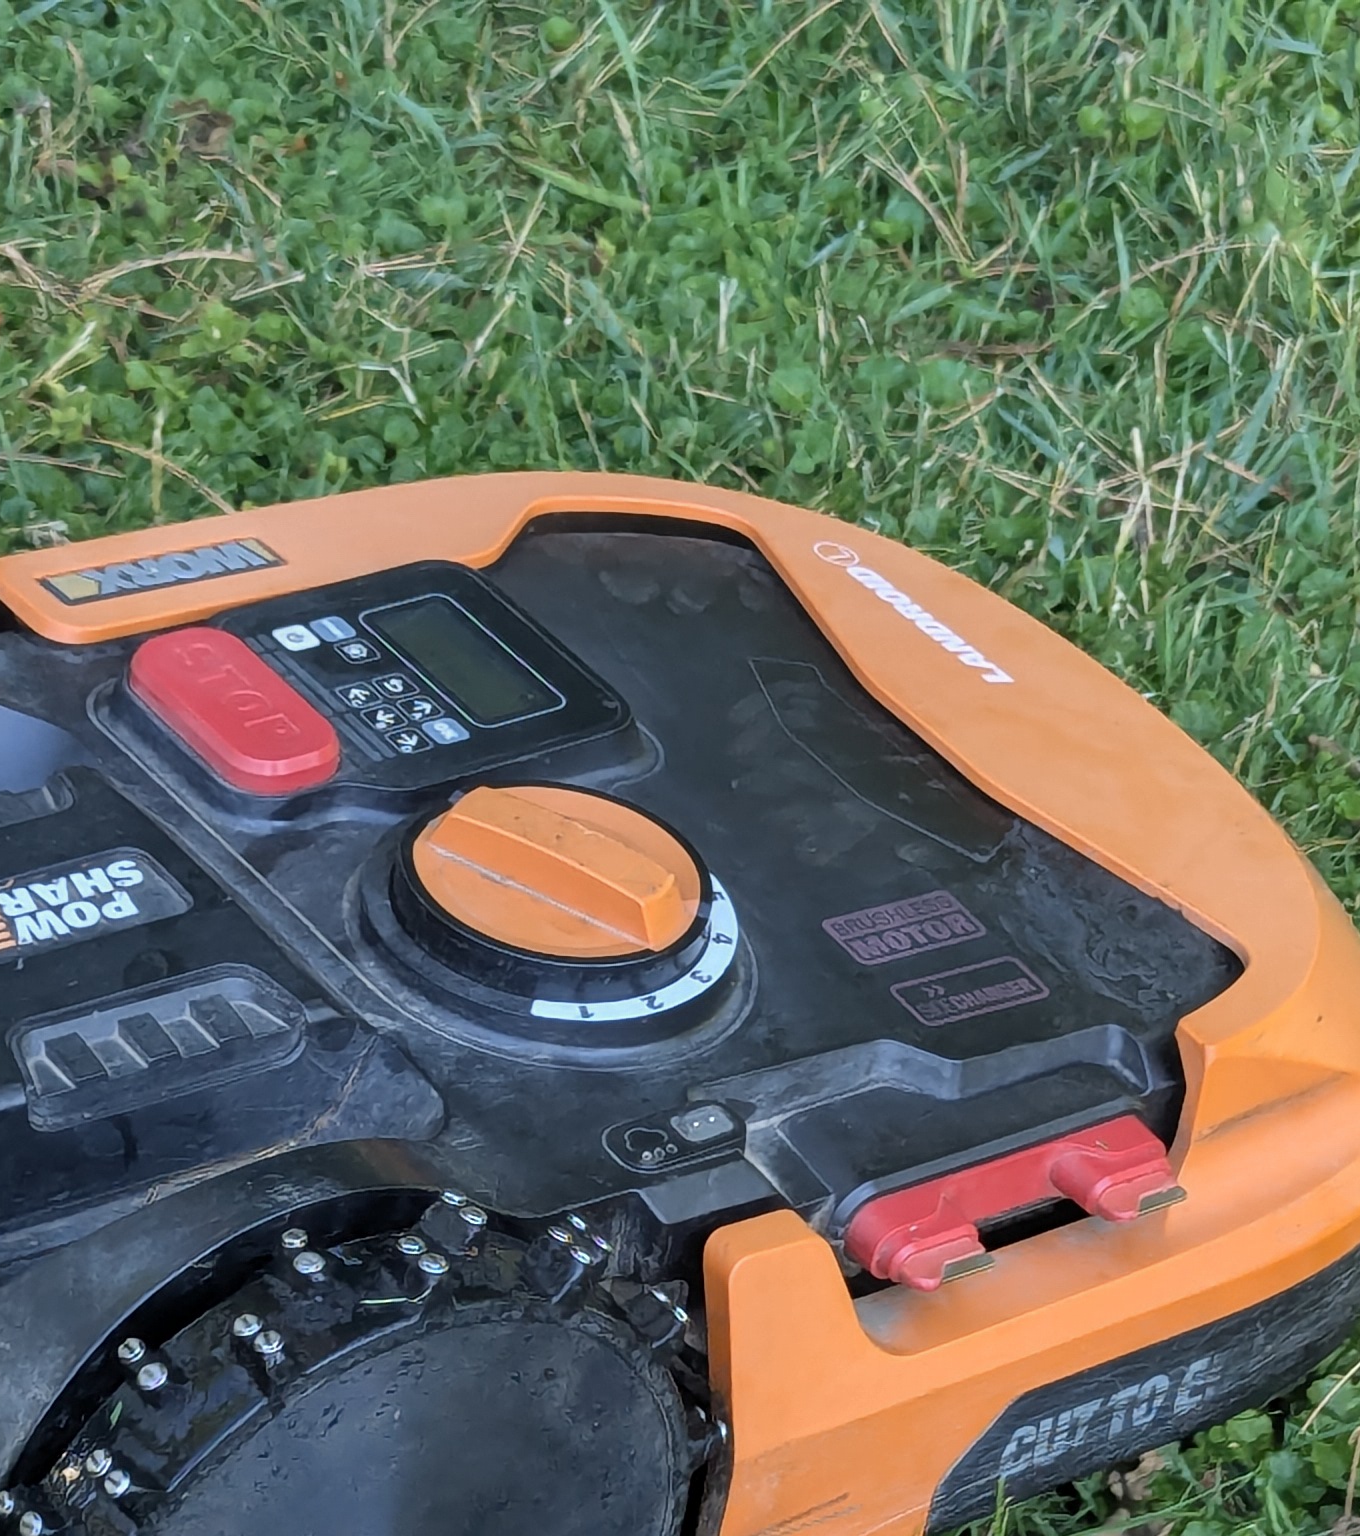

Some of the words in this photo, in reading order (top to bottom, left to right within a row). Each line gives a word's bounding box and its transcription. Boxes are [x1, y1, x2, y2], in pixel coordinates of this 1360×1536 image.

[77, 540, 268, 595] WORX
[846, 566, 1015, 683] LANDROID
[830, 895, 953, 938] BRUSHLESS
[845, 912, 978, 960] MOTOR
[689, 970, 713, 984] 3
[578, 1005, 595, 1019] 1
[640, 995, 665, 1010] 2
[999, 1400, 1102, 1478] CUT
